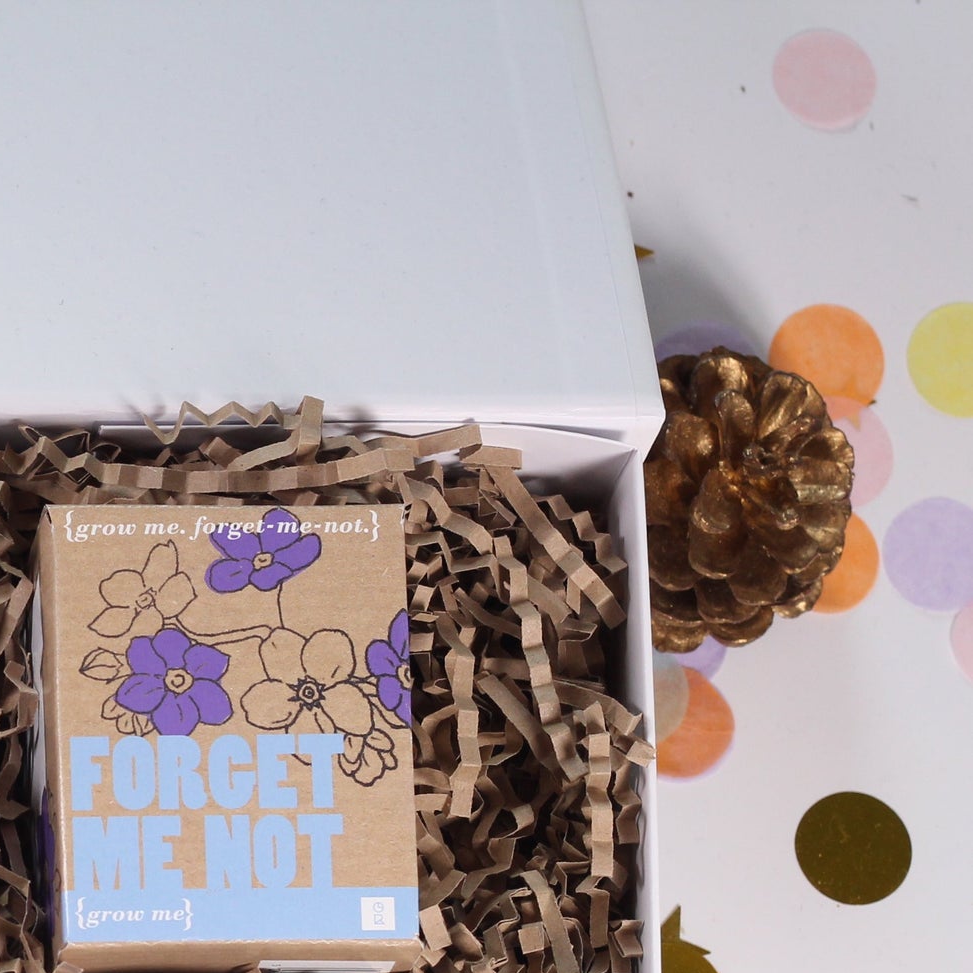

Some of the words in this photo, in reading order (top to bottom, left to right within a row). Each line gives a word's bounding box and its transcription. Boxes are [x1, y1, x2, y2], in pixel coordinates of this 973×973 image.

[144, 520, 186, 535] me.
[69, 733, 344, 811] FORGET
[73, 816, 184, 892] ME
[205, 813, 343, 889] NOT
